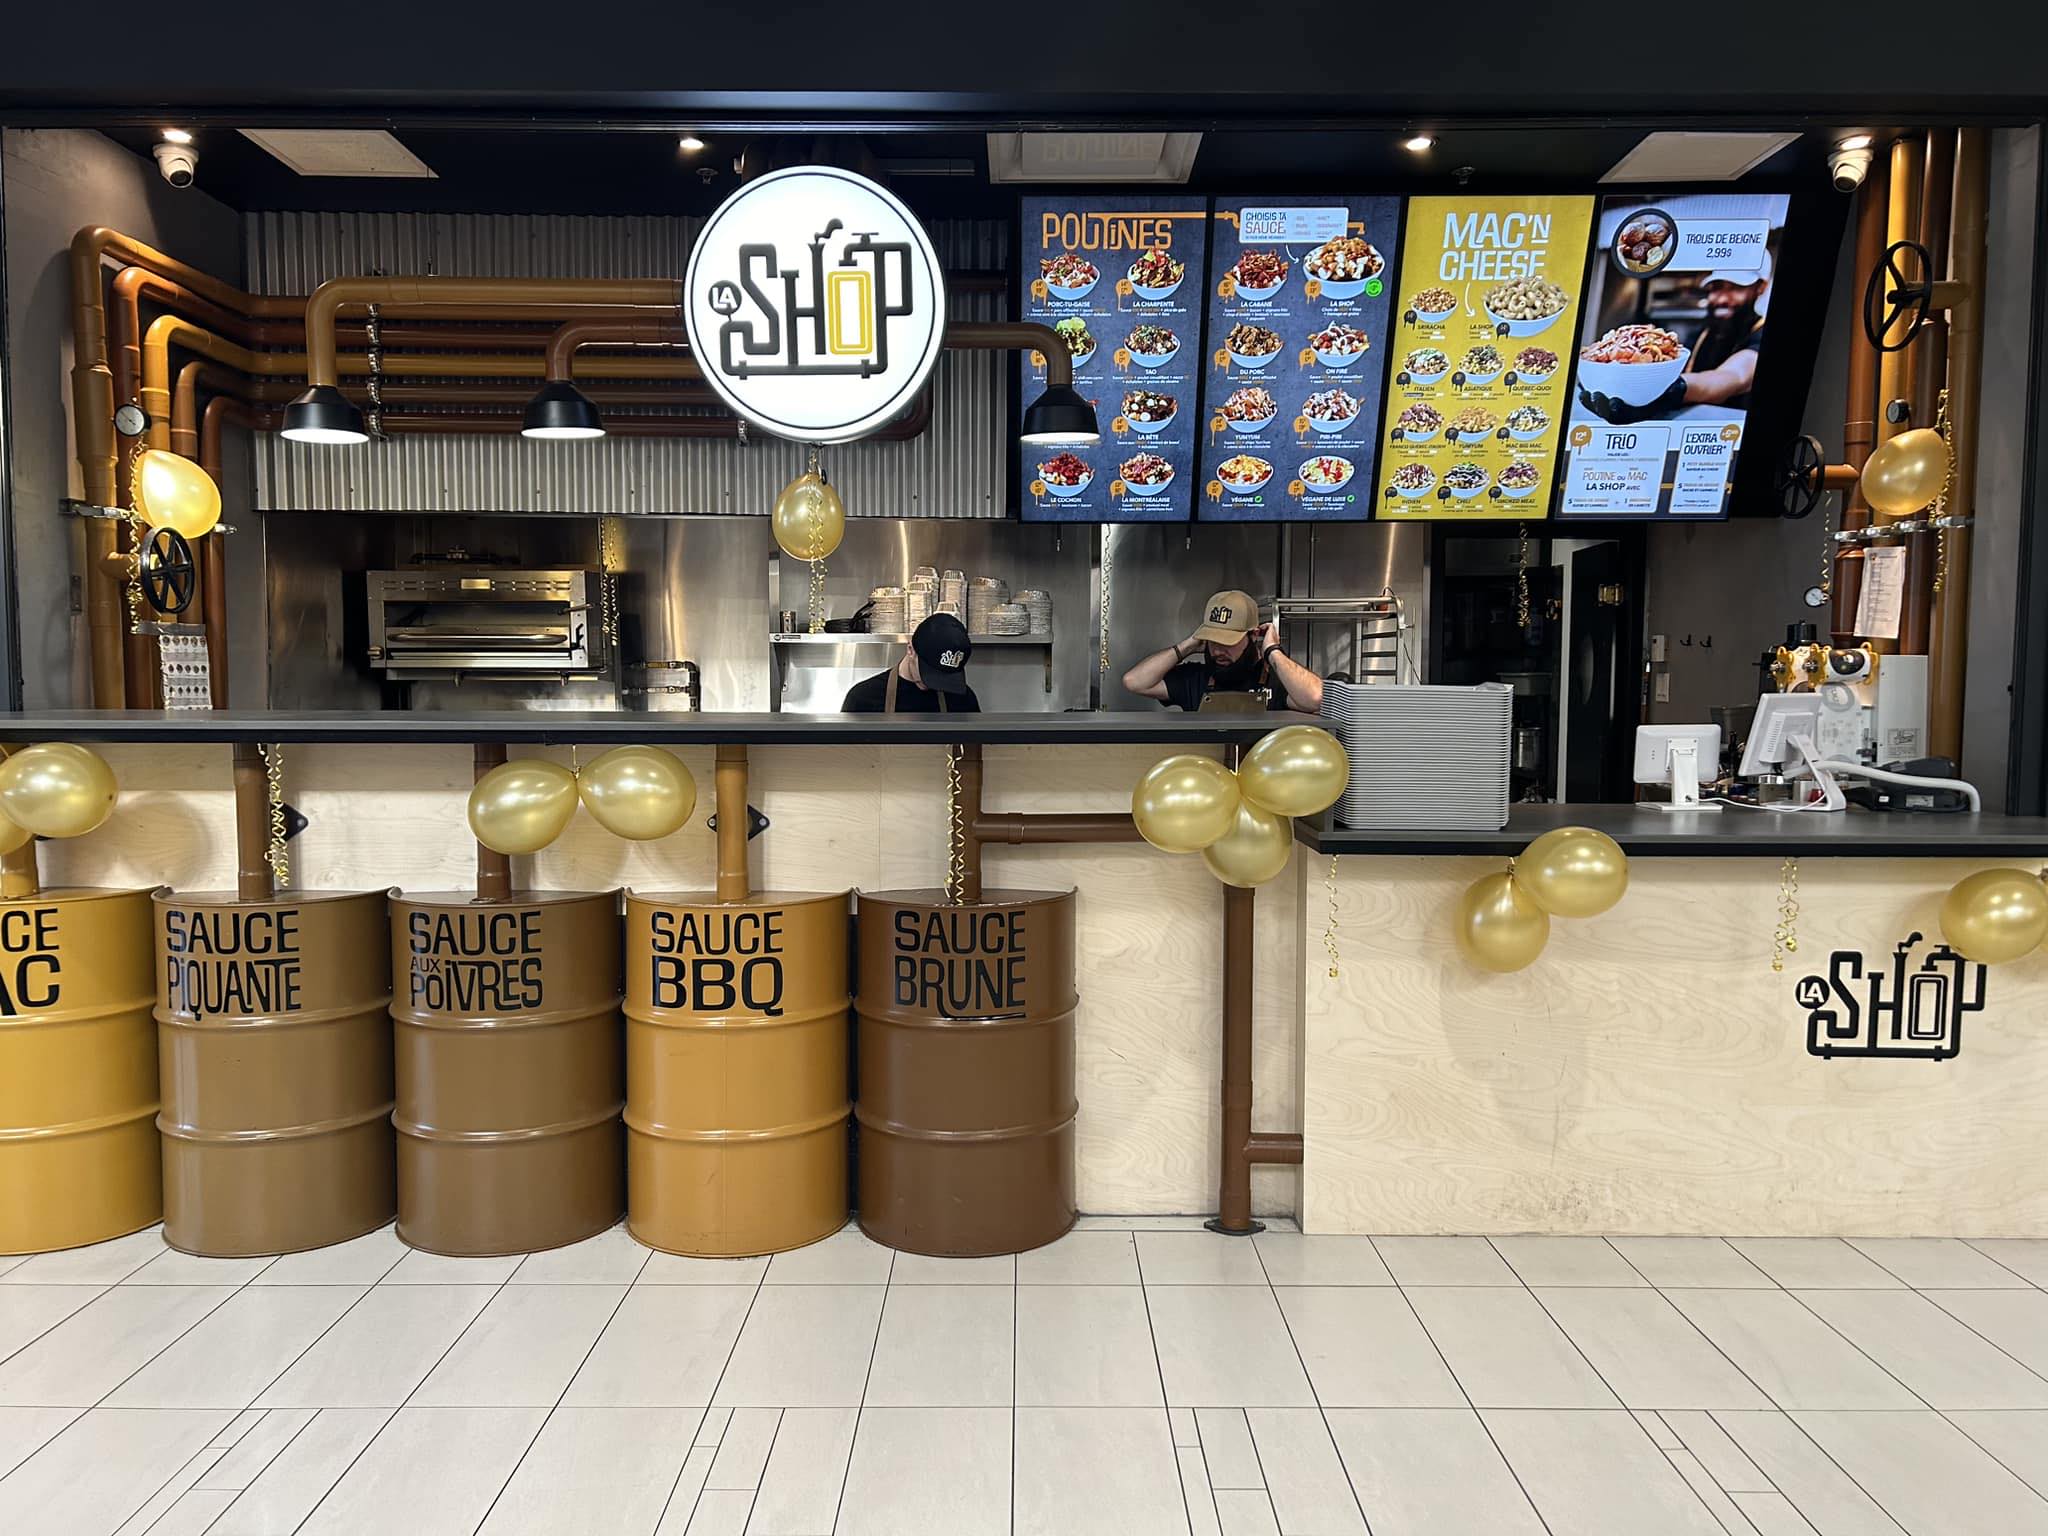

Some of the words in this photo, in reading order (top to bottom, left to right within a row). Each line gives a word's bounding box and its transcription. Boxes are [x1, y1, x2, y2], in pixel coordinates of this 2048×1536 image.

[1042, 212, 1173, 250] POUTINES
[1245, 211, 1276, 221] CHOISIS
[1278, 212, 1287, 221] TA
[1245, 221, 1287, 235] SAUCE
[1685, 233, 1714, 244] TROUS
[1715, 233, 1728, 244] DE
[1728, 233, 1762, 244] BEIGNE
[1439, 250, 1546, 281] CHEESE
[711, 286, 738, 310] LA
[720, 242, 913, 380] SHOP
[1605, 433, 1638, 450] TRIO
[1685, 433, 1718, 443] L'EXTRA
[1582, 471, 1617, 481] POUTINE
[1627, 471, 1649, 481] MAC
[1586, 483, 1598, 491] LA
[1599, 483, 1626, 491] SHOP
[166, 910, 300, 955] SAUCE
[409, 910, 543, 956] SAUCE
[651, 910, 784, 956] SAUCE
[894, 910, 1027, 954] SAUCE
[409, 957, 441, 974] AUX
[167, 955, 302, 1021] PIQUANTE
[409, 957, 544, 1012] POIVRES
[651, 955, 784, 1017] BBQ
[894, 955, 1027, 1021] BRUNE
[1799, 981, 1826, 1005] LA
[1806, 949, 1988, 1061] SHOP
